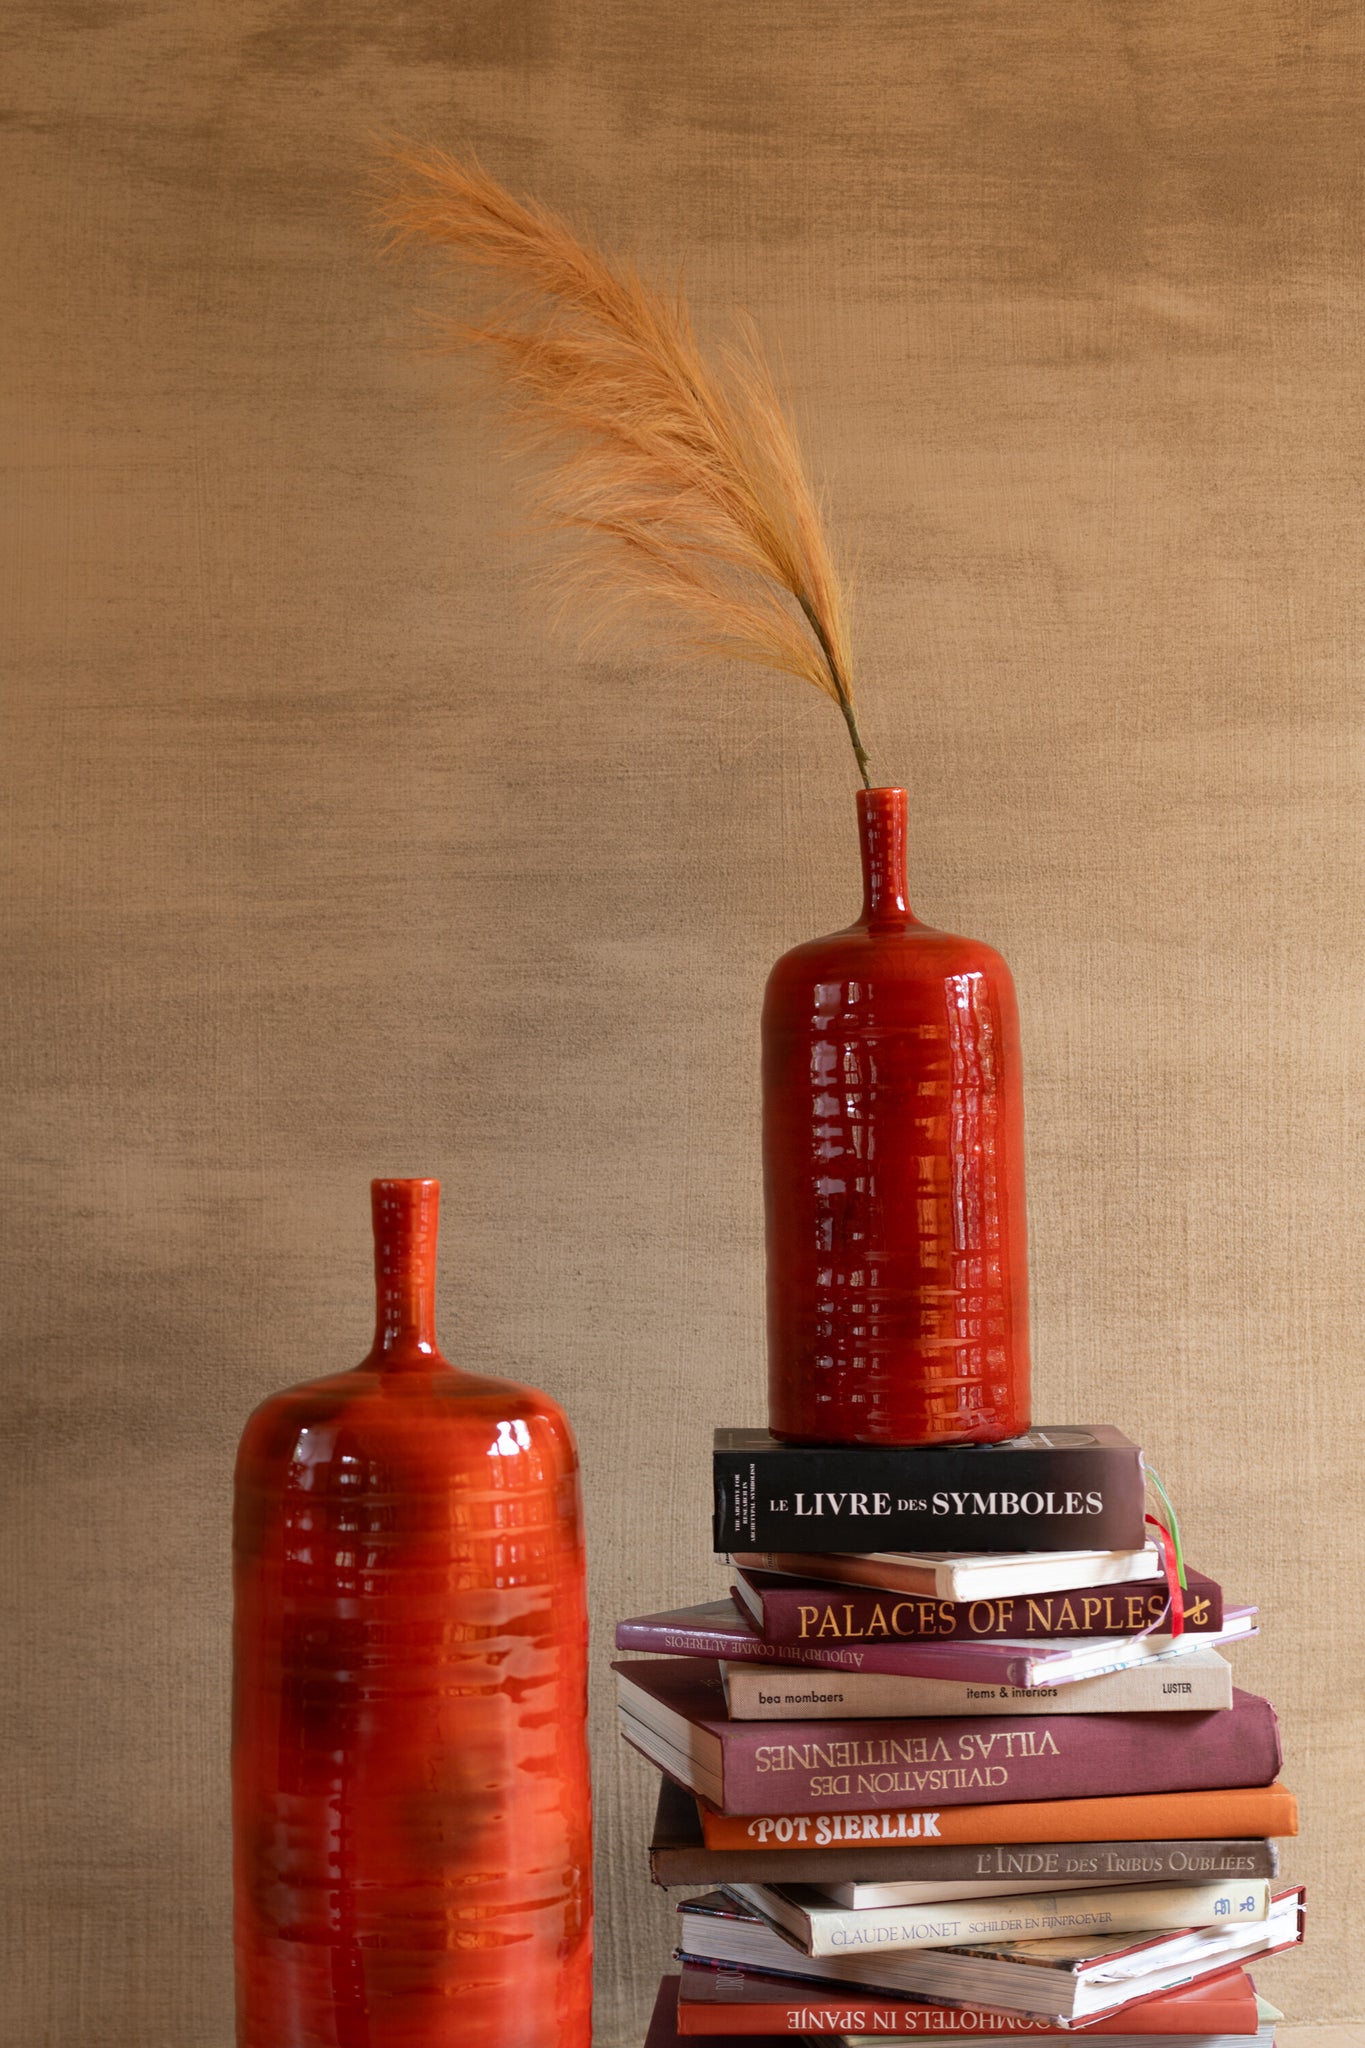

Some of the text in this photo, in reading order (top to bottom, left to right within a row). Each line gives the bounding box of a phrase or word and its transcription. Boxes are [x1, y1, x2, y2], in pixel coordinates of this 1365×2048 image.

[742, 1481, 748, 1489] IN
[769, 1491, 1103, 1516] LE LIVRE DES SYMBOLES
[797, 1600, 958, 1639] PALACES
[967, 1600, 1014, 1634] OF
[1025, 1595, 1166, 1633] NAPLES
[664, 1635, 865, 1668] AUJOURD'HUI COMME AUTREFOIS
[758, 1690, 844, 1705] bea mombaers
[966, 1687, 1058, 1699] items & interiors
[1162, 1682, 1192, 1695] LUSTER
[754, 1730, 1061, 1773] VILLAS VENITIENNES
[810, 1766, 1009, 1797] CIVILISATION DES
[747, 1812, 942, 1845] POT SIERLIJK
[1065, 1857, 1098, 1873] DES
[1100, 1852, 1163, 1872] TRIBUS
[1168, 1851, 1256, 1872] OUBLIÉES
[831, 1912, 1113, 1946] CLAUDE MONET SCHILDER EN FIJNPROEVER
[786, 2010, 866, 2031] SPANJE
[873, 2011, 898, 2030] IN
